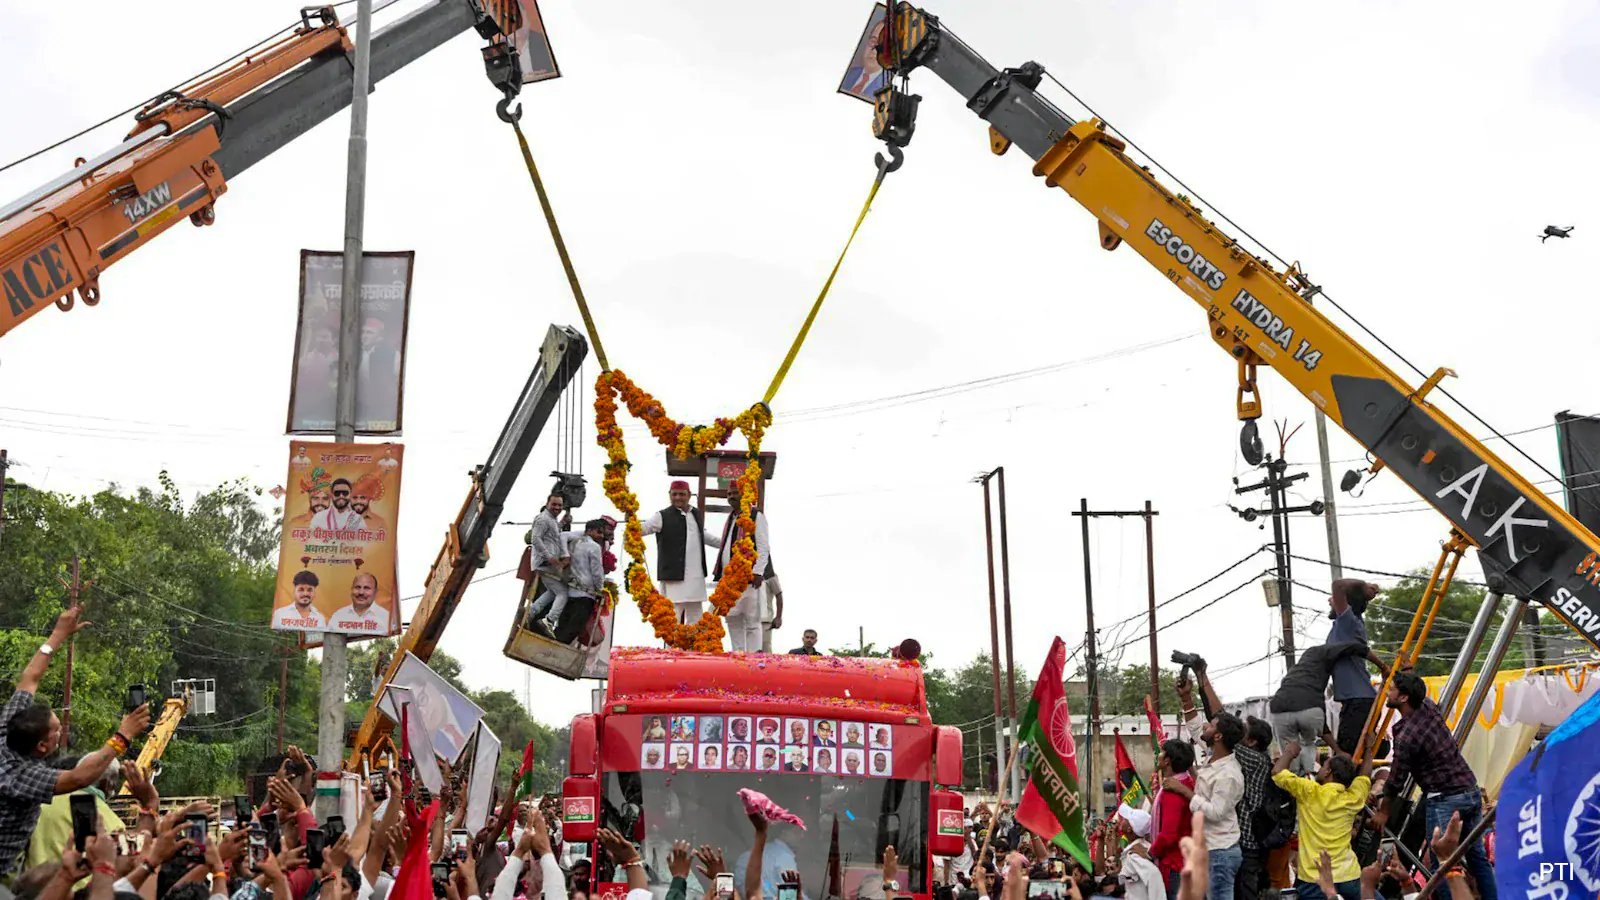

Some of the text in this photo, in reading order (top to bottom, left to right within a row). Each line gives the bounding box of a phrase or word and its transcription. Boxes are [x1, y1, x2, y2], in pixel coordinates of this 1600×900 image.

[124, 181, 172, 224] 14XW
[1, 243, 73, 317] ACE
[1145, 218, 1227, 291] ESCORTS
[1230, 288, 1295, 351] HYDRA
[1292, 338, 1324, 371] 14
[1550, 587, 1600, 641] SERV
[1518, 794, 1543, 860] जय
